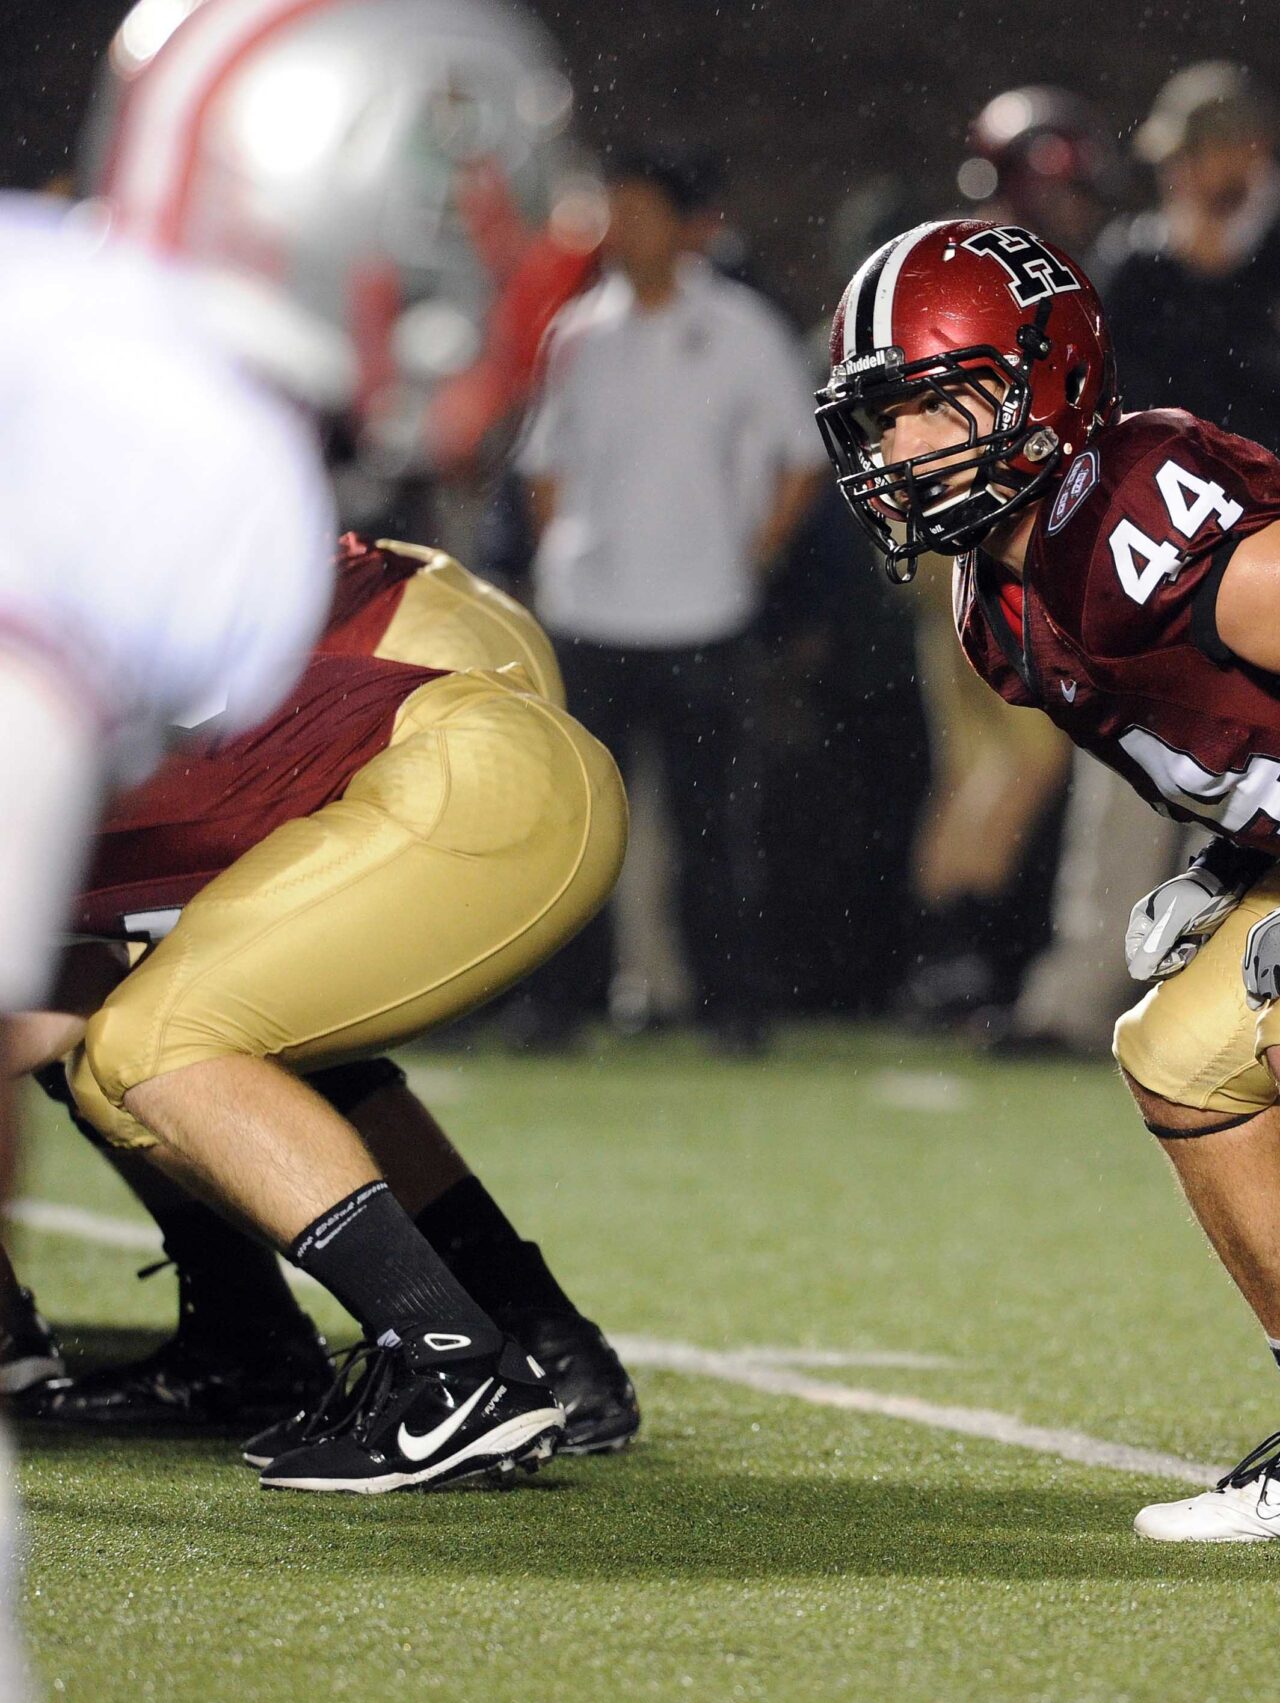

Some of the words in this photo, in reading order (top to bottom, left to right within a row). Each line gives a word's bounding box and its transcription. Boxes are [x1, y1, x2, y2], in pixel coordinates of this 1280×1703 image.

[960, 225, 1081, 307] H
[845, 349, 886, 375] Riddell
[1108, 460, 1244, 605] 44
